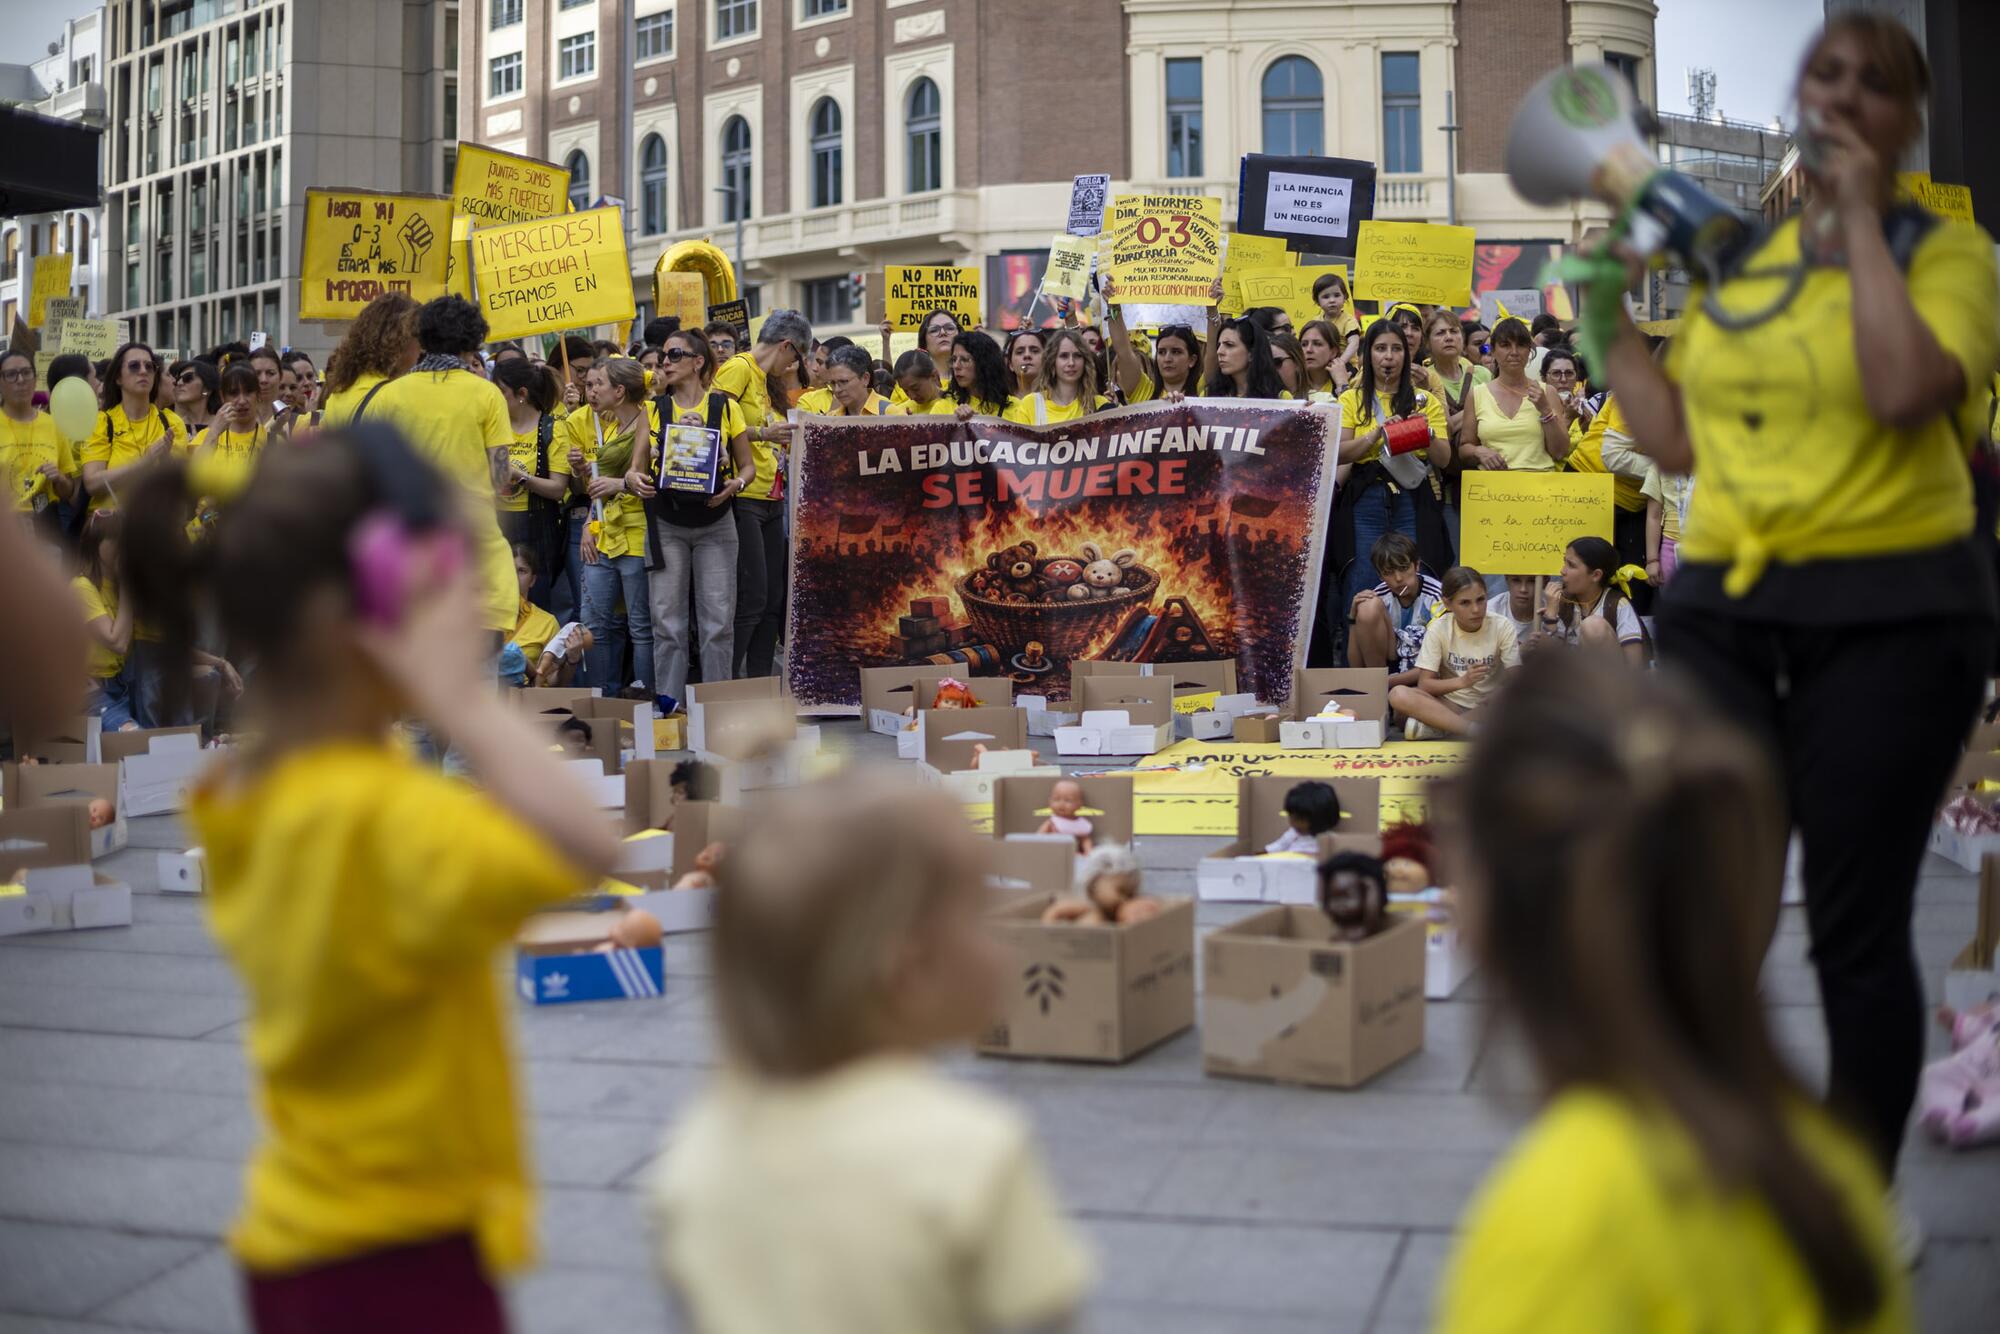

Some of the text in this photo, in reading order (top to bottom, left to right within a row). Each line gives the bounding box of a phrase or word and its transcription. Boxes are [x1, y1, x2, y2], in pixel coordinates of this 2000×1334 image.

[525, 169, 551, 188] SOMOS
[1283, 184, 1296, 192] LA
[1298, 185, 1344, 196] INFANCIA
[509, 187, 553, 213] FUERTES!
[1143, 196, 1203, 210] INFORMES
[1293, 199, 1308, 207] NO
[374, 202, 394, 225] YA!
[1274, 212, 1340, 225] UN NEGOCIO!!
[353, 223, 381, 243] 0-3
[1136, 215, 1192, 248] 0-3
[1189, 222, 1219, 256] RATIOS
[341, 242, 381, 260] ES LA
[1113, 246, 1177, 265] BUROCRACIA
[337, 258, 370, 274] ETAPA
[1133, 266, 1158, 274] MUCHO
[903, 269, 962, 283] NO HAY
[1124, 274, 1212, 283] MUCHA RESPONSABILIDAD
[489, 273, 597, 311] ESTAMOS EN
[891, 282, 977, 298] ALTERNATIVA
[1129, 285, 1151, 296] POCO
[527, 301, 574, 323] LUCHA
[713, 310, 745, 321] EDUCAR
[857, 424, 1266, 476] LA EDUCACIÓN INFANTIL
[922, 460, 1187, 509] SE MUERE
[1480, 518, 1493, 527] en
[1504, 515, 1522, 526] la
